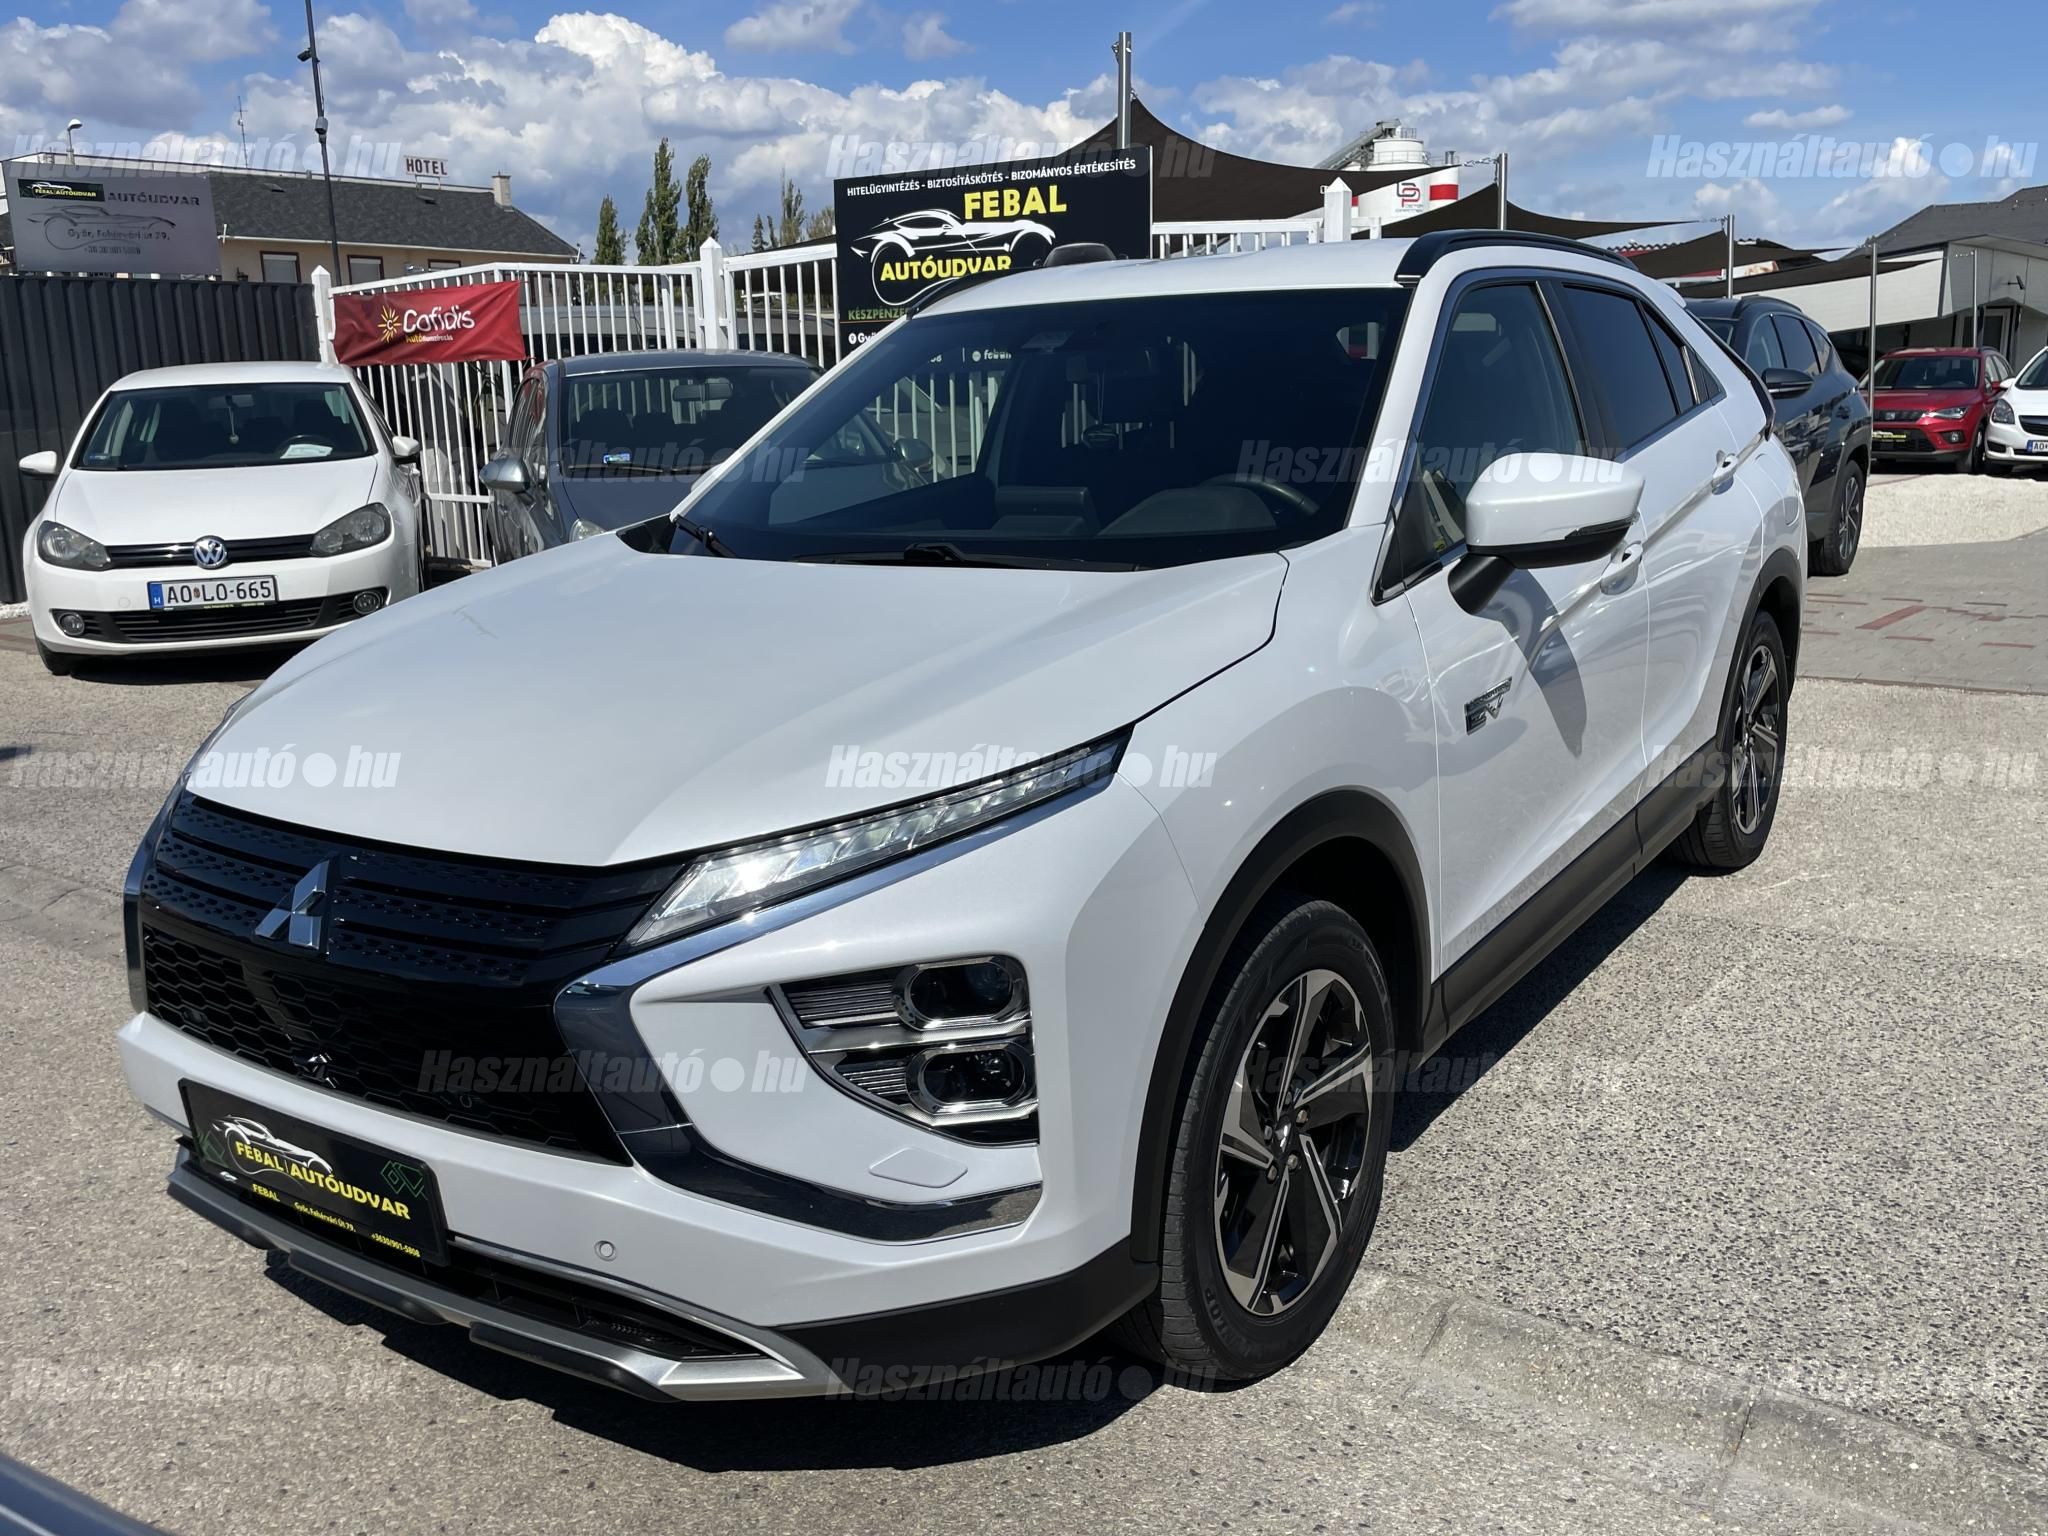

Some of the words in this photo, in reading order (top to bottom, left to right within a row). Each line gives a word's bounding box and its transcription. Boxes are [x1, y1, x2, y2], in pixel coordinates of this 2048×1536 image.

[406, 158, 447, 175] HOTEL
[847, 179, 920, 197] HITELÜGYINTÉZÉS
[927, 172, 1003, 189] BIZTOSÍTÁSKÖTÉS
[1011, 166, 1072, 181] BIZOMÁNYOS
[1073, 158, 1137, 176] ÉRTÉKESÍTÉS
[108, 191, 201, 206] AUTÓUDVAR
[964, 185, 1067, 219] FEBAL
[880, 255, 1012, 282] AUTÓUDVAR
[402, 305, 476, 334] Cofidis
[235, 1141, 284, 1172] FEBAL
[290, 1164, 411, 1220] AUTÓUDVAR
[252, 1184, 281, 1202] FEBAL
